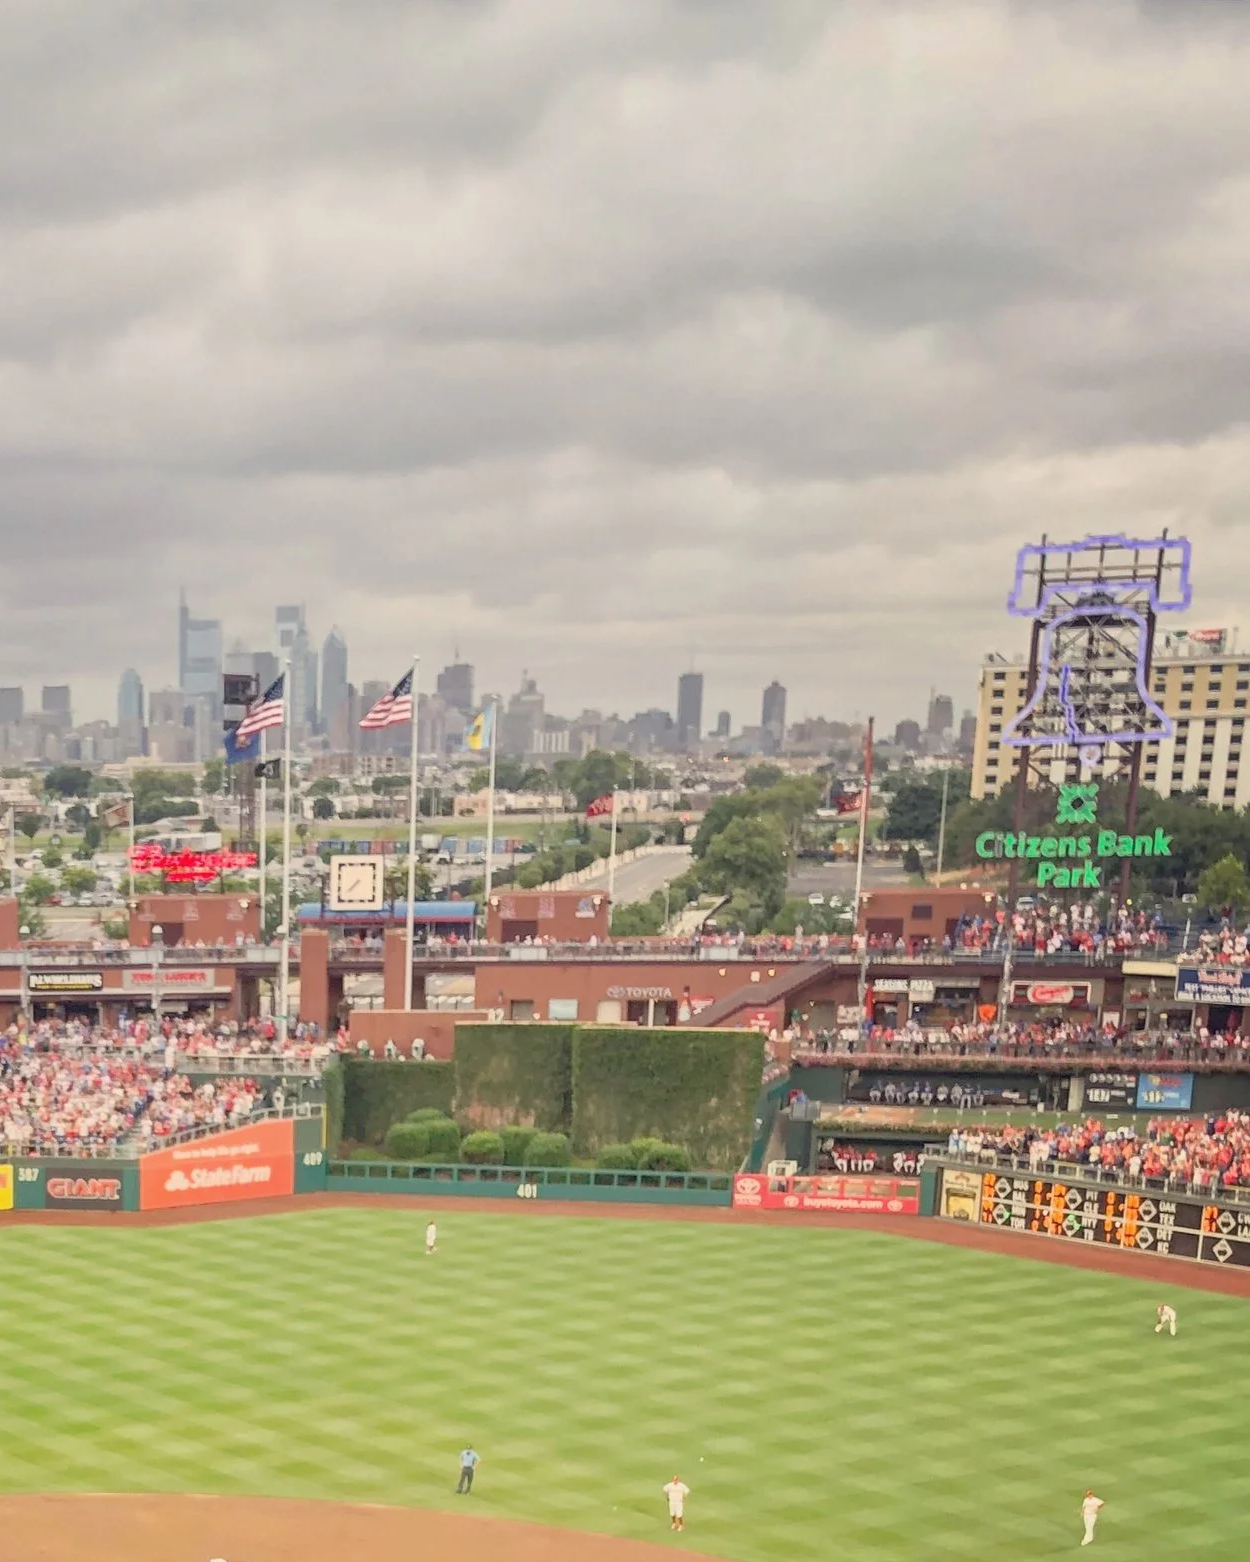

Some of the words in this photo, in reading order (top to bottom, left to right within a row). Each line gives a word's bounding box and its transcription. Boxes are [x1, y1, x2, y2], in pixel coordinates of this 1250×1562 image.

[975, 830, 1092, 859] Citizens
[1097, 827, 1174, 857] Bank
[1037, 860, 1102, 888] Park
[626, 986, 673, 999] TOYOTA
[303, 1151, 323, 1166] 409
[47, 1178, 121, 1200] GIANT
[516, 1183, 538, 1199] 401
[1159, 1200, 1176, 1213] OAK
